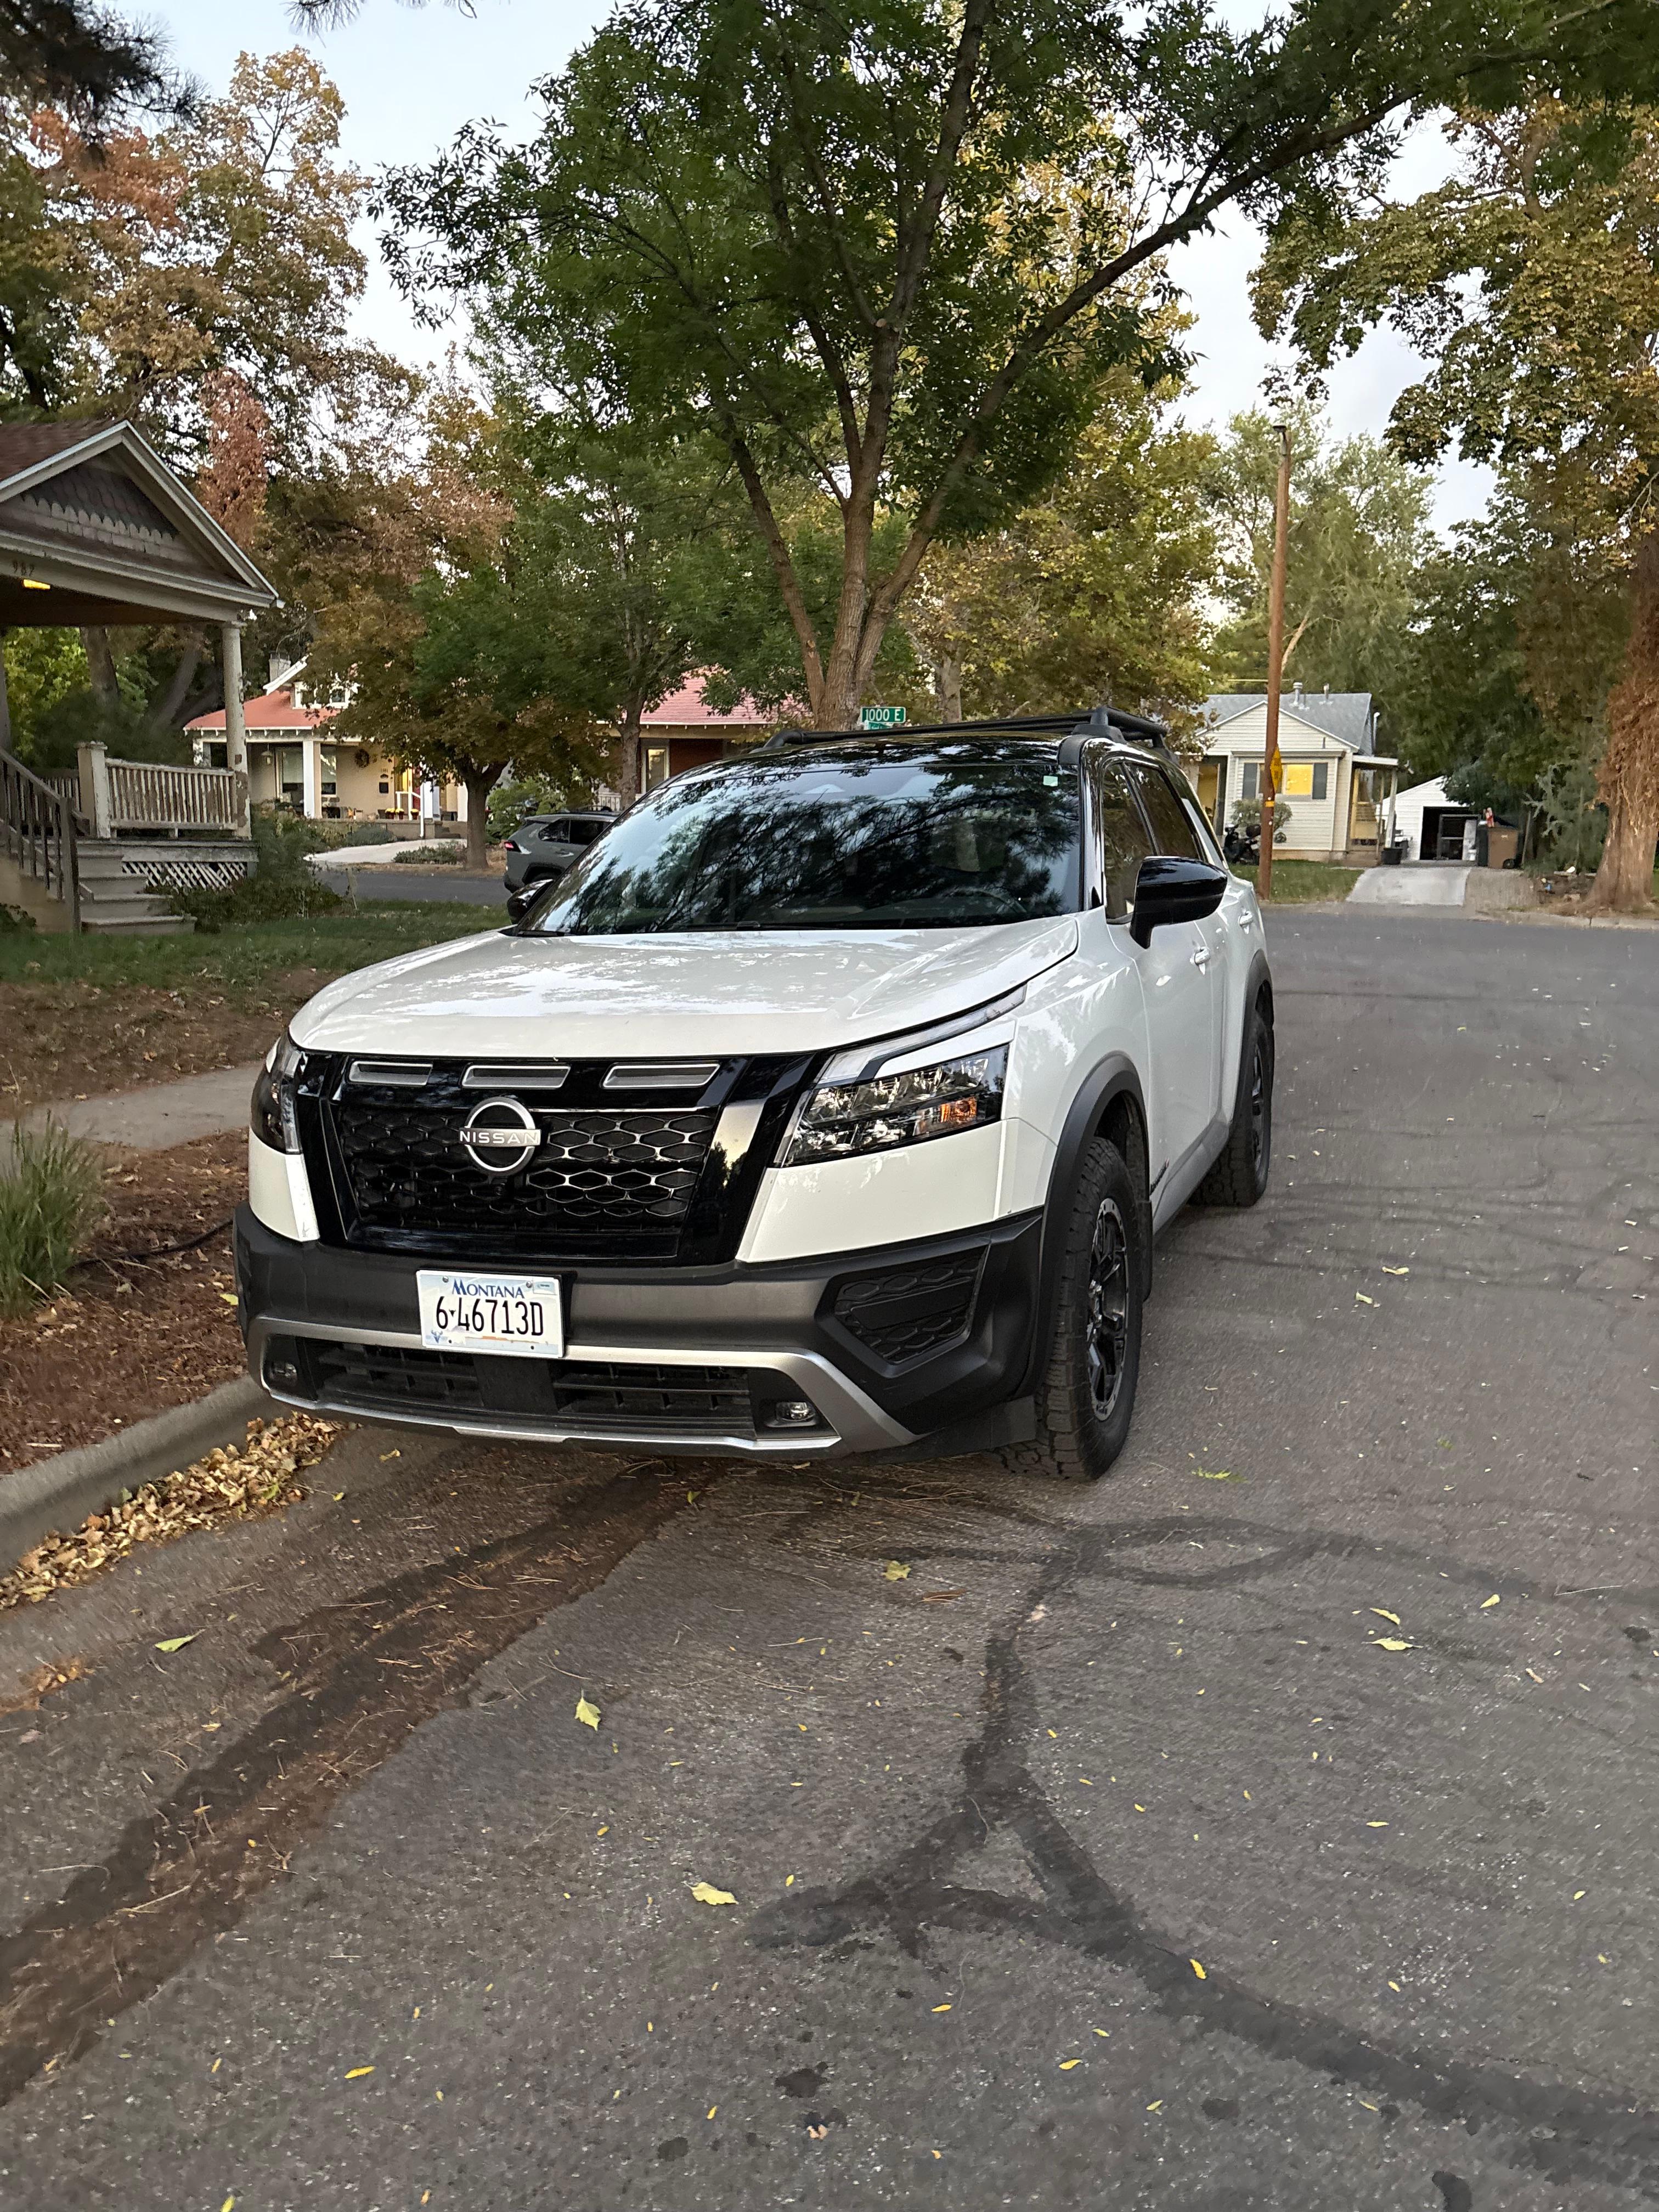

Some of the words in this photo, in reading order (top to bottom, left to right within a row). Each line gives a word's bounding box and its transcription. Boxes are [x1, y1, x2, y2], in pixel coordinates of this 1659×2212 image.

[865, 709, 890, 721] 1000
[894, 709, 901, 721] E
[460, 1130, 538, 1144] NISSAN
